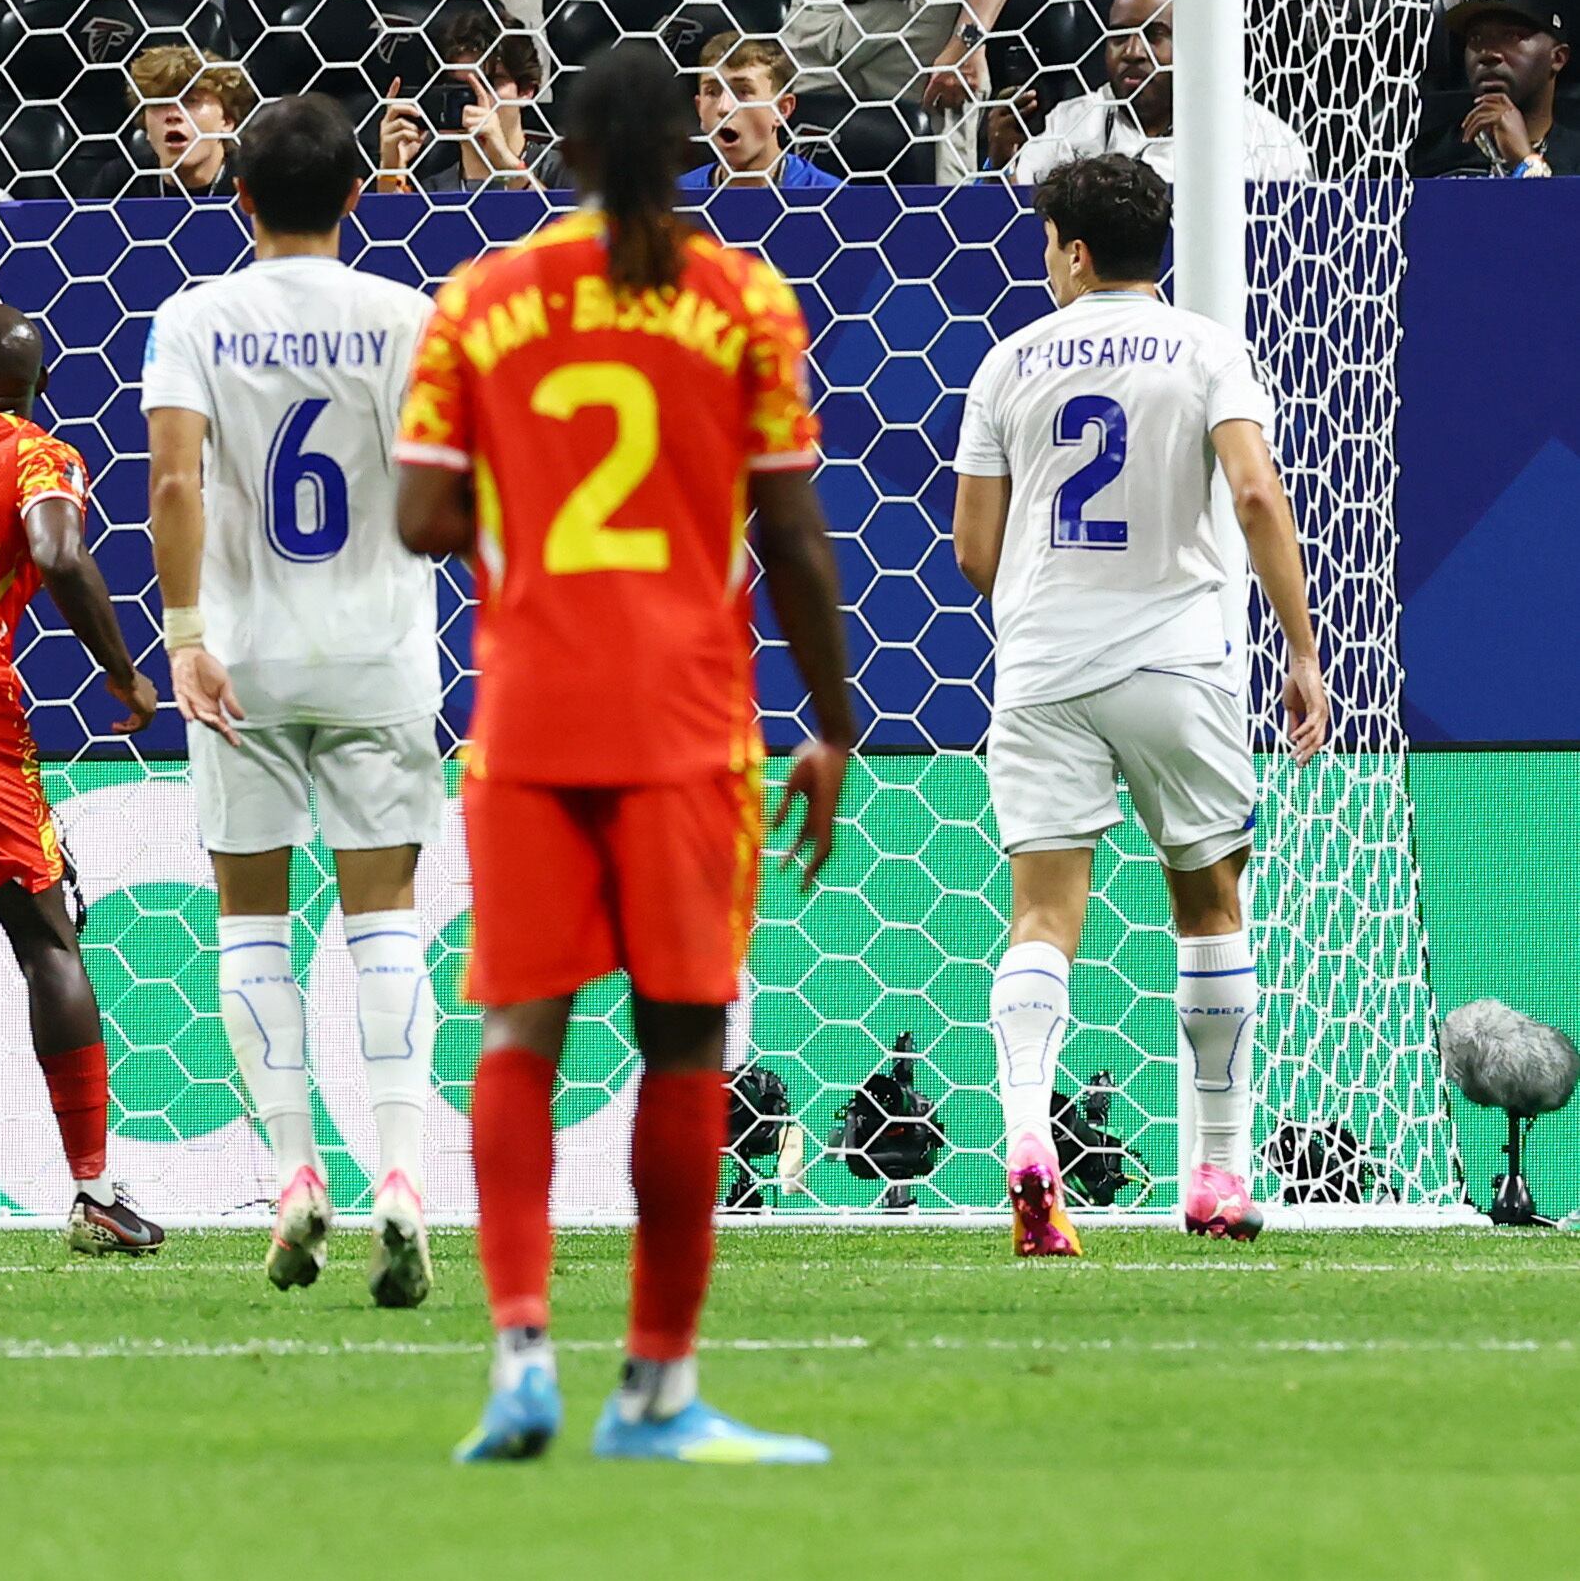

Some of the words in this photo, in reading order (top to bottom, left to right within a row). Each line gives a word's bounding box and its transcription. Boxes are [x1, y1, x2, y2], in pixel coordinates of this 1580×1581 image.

[213, 330, 390, 369] MOZGOVOY
[1016, 336, 1183, 380] KHUSANOV
[264, 398, 351, 564] 6
[530, 360, 671, 575] 2
[1050, 395, 1129, 551] 2
